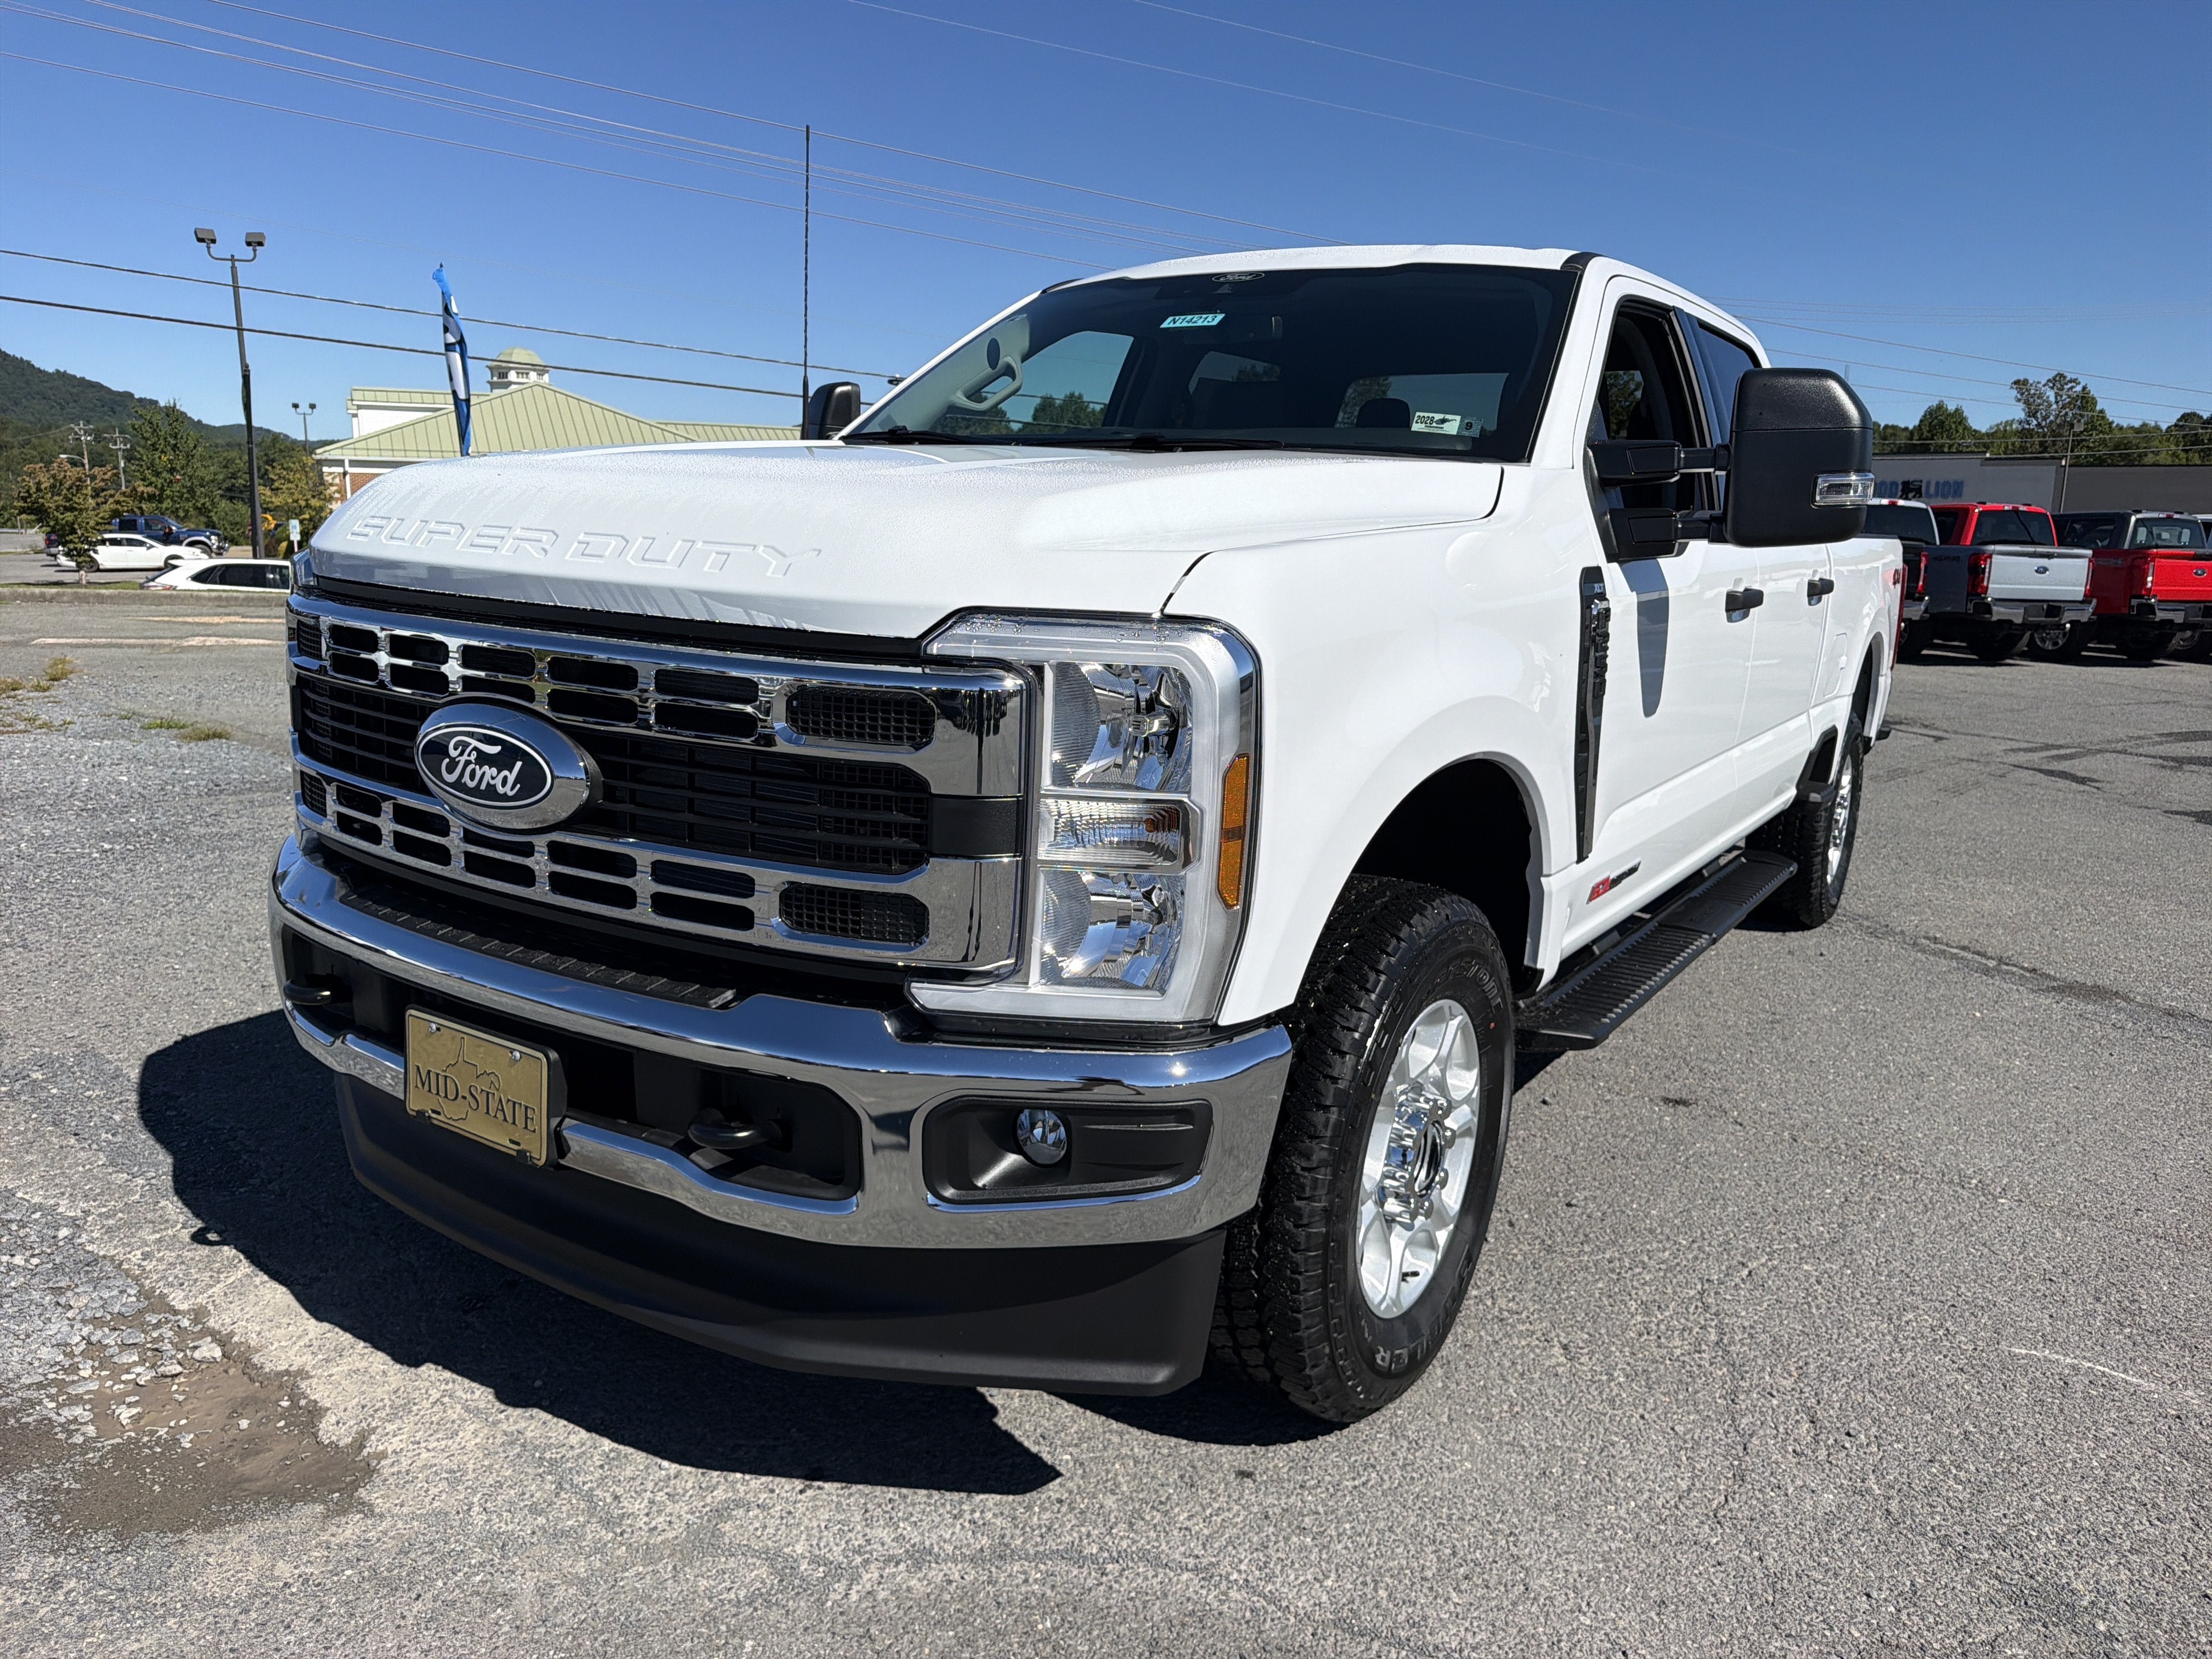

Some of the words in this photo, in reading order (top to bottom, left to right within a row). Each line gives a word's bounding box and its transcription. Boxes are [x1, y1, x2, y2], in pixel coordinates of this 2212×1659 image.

[1167, 315, 1217, 325] N14213
[1415, 415, 1435, 425] 2028
[1465, 421, 1473, 431] 9
[1924, 479, 1964, 499] LION
[346, 515, 560, 559] SUPER
[564, 531, 822, 578] DUTY
[1593, 583, 1604, 594] XLT
[441, 735, 523, 797] Ford
[415, 1064, 537, 1133] MID-STATE
